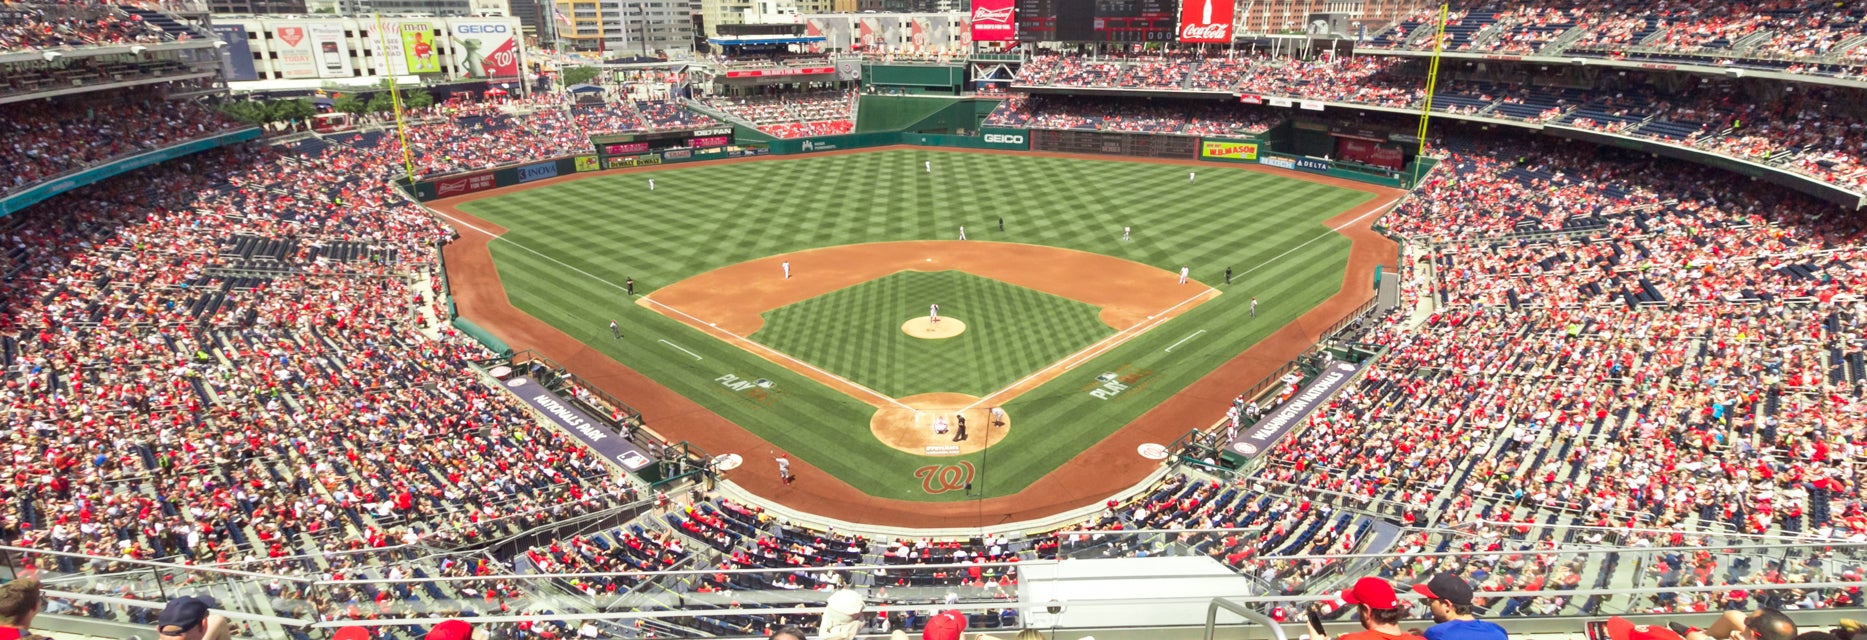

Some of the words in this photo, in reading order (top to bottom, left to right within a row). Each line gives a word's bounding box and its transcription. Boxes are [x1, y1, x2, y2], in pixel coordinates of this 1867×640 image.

[458, 24, 506, 34] GEICO
[1182, 23, 1228, 39] Coca-Cola
[495, 50, 512, 67] W
[984, 133, 1023, 144] GEICO
[528, 165, 556, 177] INOVA
[1304, 161, 1326, 170] DELTA
[715, 374, 756, 391] PLAY
[1089, 380, 1128, 400] PLAY
[1251, 402, 1309, 440] WASHINGTON
[1300, 372, 1344, 402] NATIONALS
[533, 395, 583, 426] NATIONALS
[576, 422, 607, 442] PARK
[914, 460, 975, 494] W
